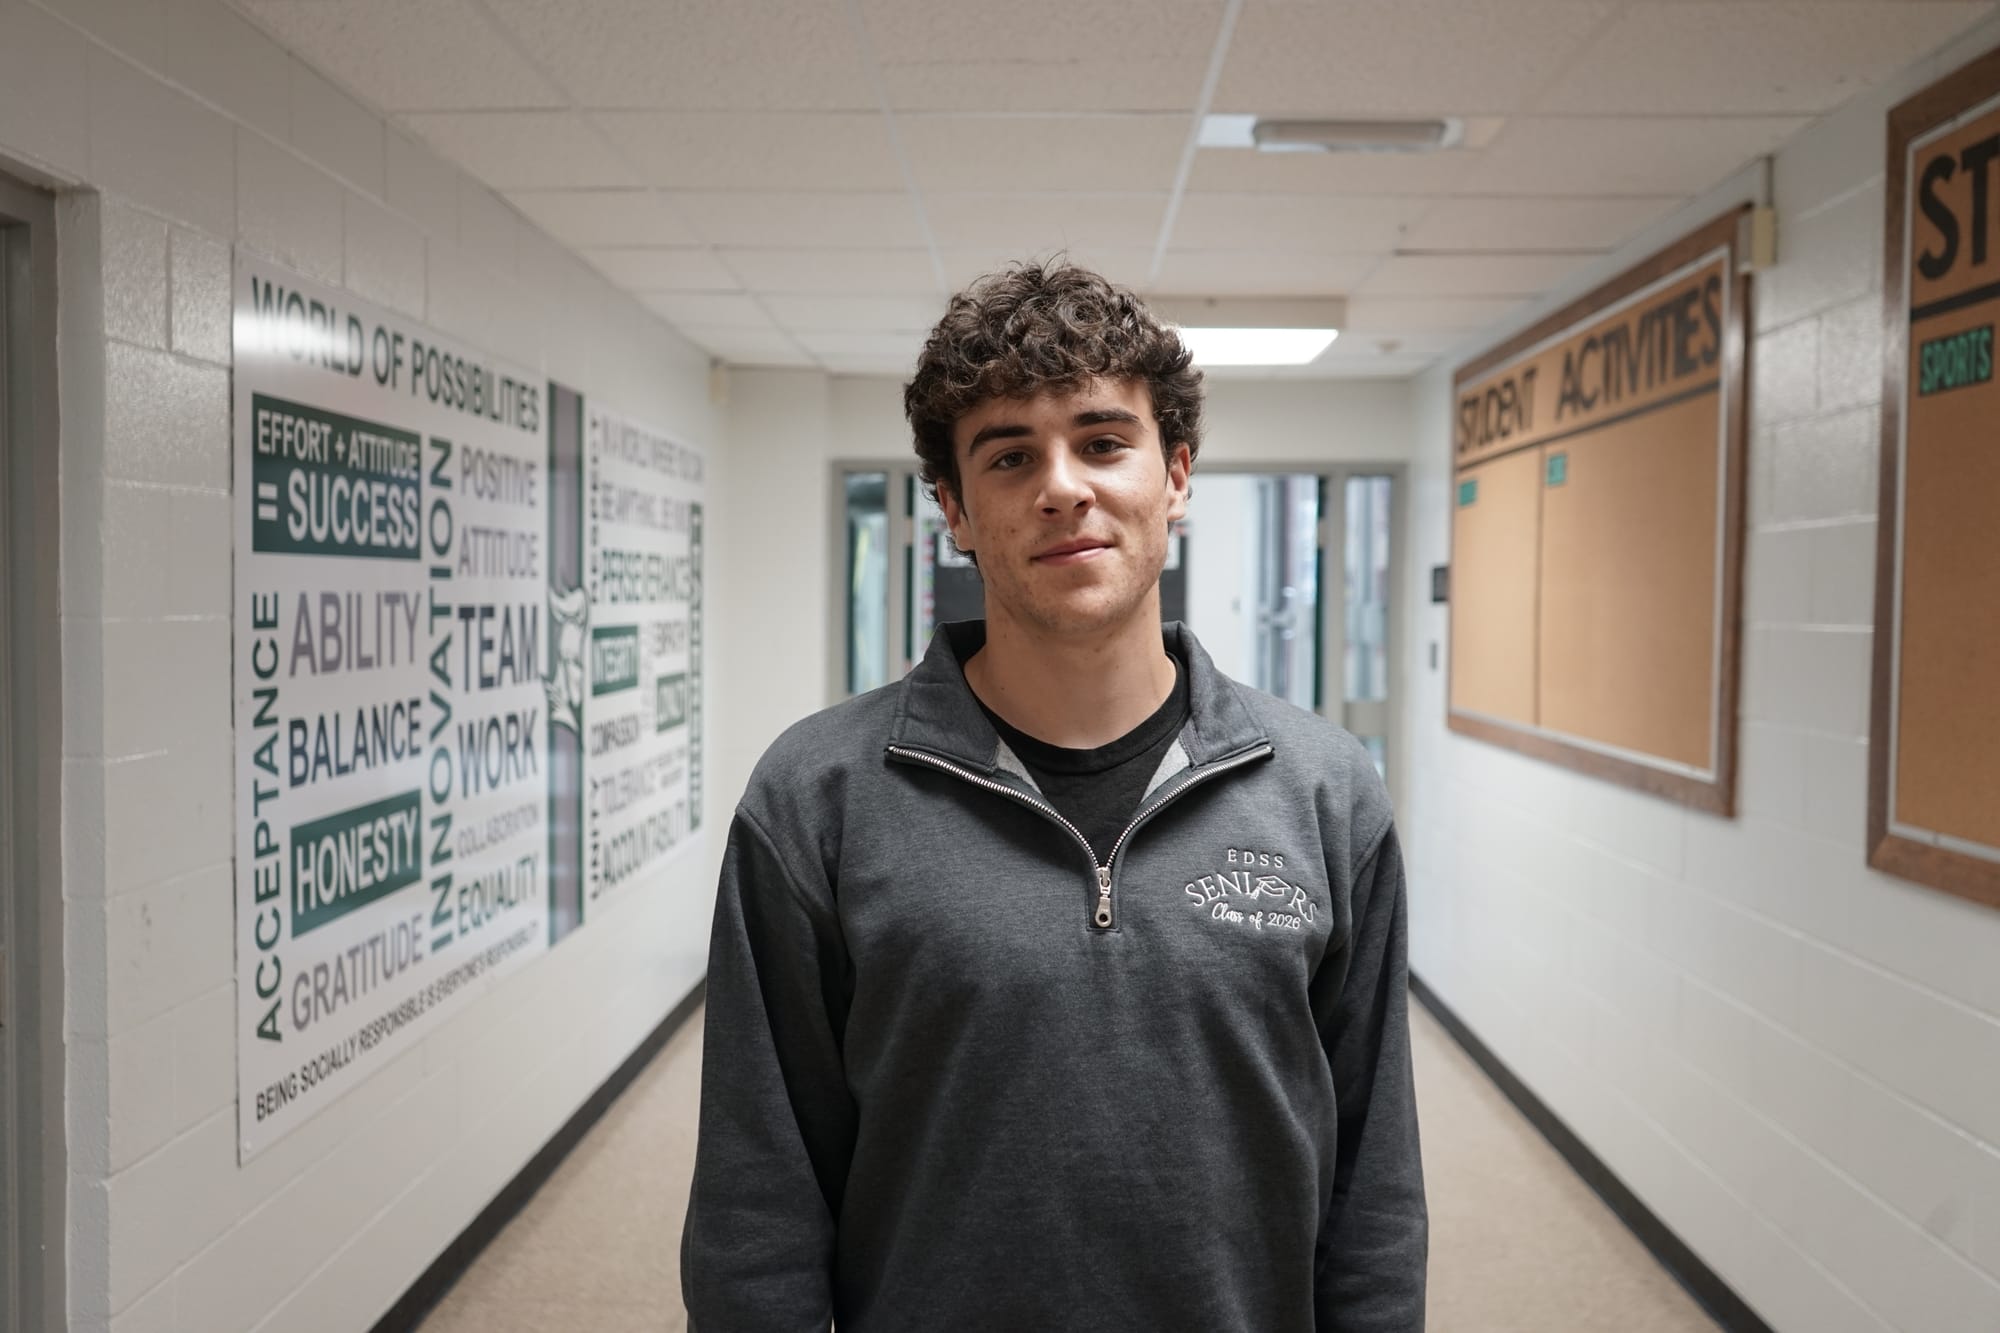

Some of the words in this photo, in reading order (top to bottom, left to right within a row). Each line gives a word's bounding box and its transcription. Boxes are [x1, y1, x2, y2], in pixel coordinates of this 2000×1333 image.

[1917, 131, 2000, 280] ST
[252, 277, 364, 377] WORLD
[373, 326, 404, 389] OF
[411, 340, 540, 434] POSSIBILITIES
[1458, 366, 1538, 452] STUDENT
[1555, 275, 1722, 421] ACTIVITIES
[1920, 325, 1991, 394] SPORTS
[258, 409, 332, 464] EFFORT
[348, 435, 420, 481] ATTITUDE
[461, 445, 538, 507] POSITIVE
[288, 468, 420, 549] SUCCESS
[458, 526, 539, 579] ATTITUDE
[289, 591, 421, 678] ABILITY
[459, 605, 539, 693] TEAM
[430, 437, 454, 954] INNOVATION
[289, 699, 421, 789] BALANCE
[458, 708, 538, 799] WORK
[252, 592, 282, 1043] ACCEPTANCE
[296, 806, 418, 915] HONESTY
[457, 853, 540, 937] EQUALITY
[1211, 902, 1245, 922] Class
[1249, 911, 1263, 930] of
[1267, 912, 1301, 929] 2026
[291, 914, 423, 1031] GRATITUDE
[256, 1074, 298, 1122] BEING
[300, 1038, 357, 1092] SOCIALLY
[359, 991, 426, 1050] RESPONSIBLE
